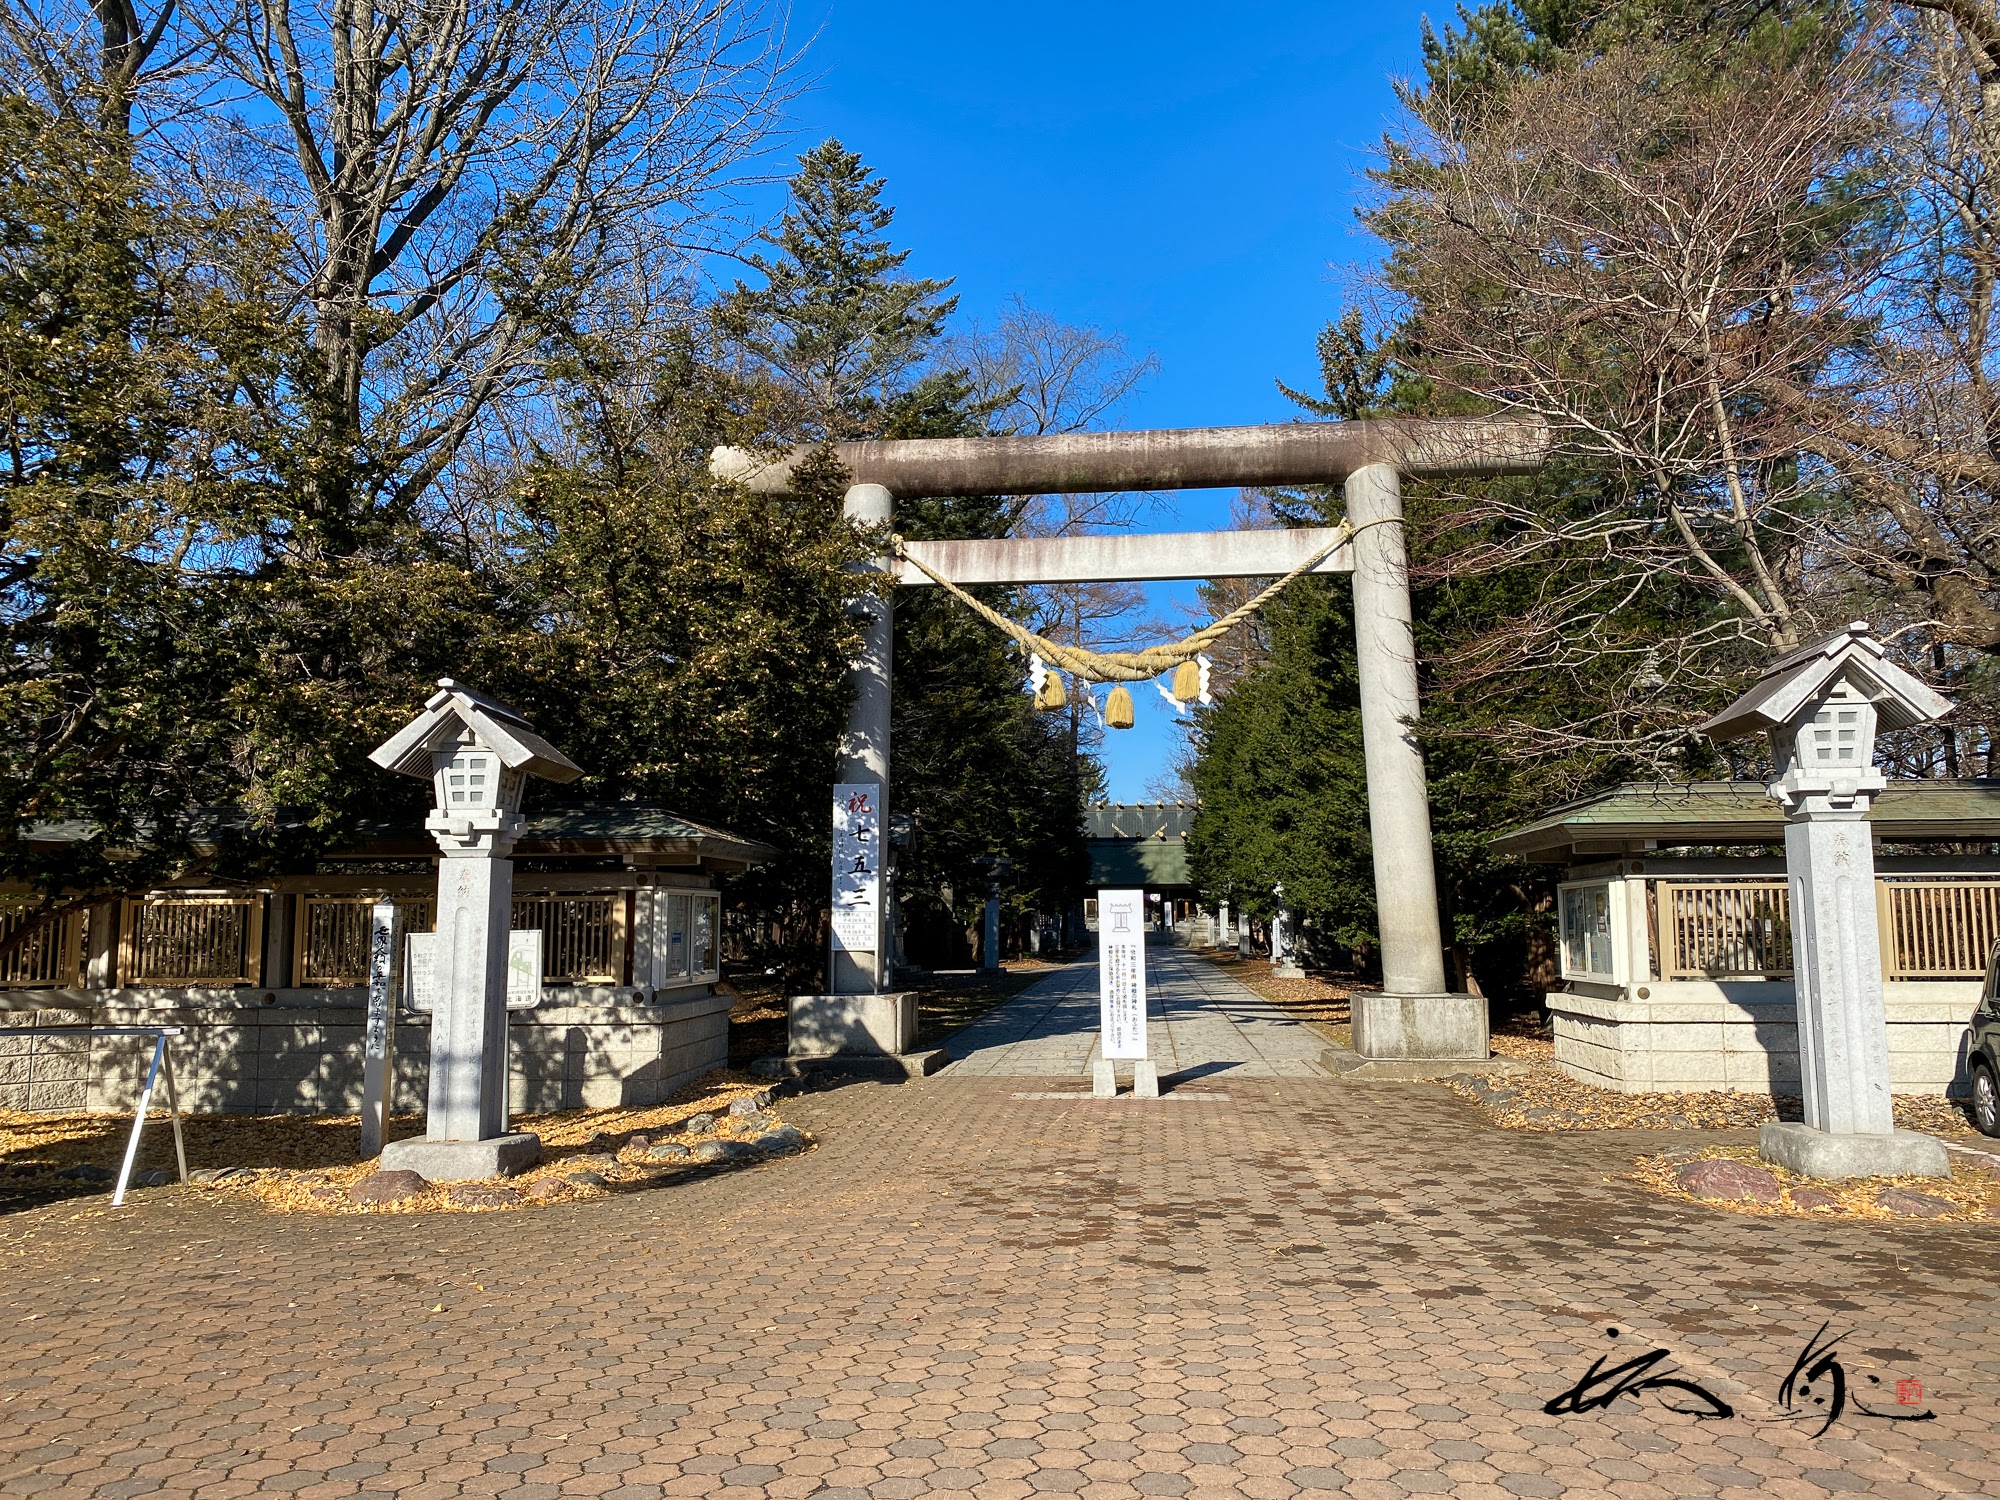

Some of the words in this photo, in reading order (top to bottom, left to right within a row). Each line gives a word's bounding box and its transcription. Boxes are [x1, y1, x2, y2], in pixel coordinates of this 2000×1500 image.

[848, 791, 872, 906] 祝七五三
[371, 925, 390, 1050] 世界人類が平和でありますように
